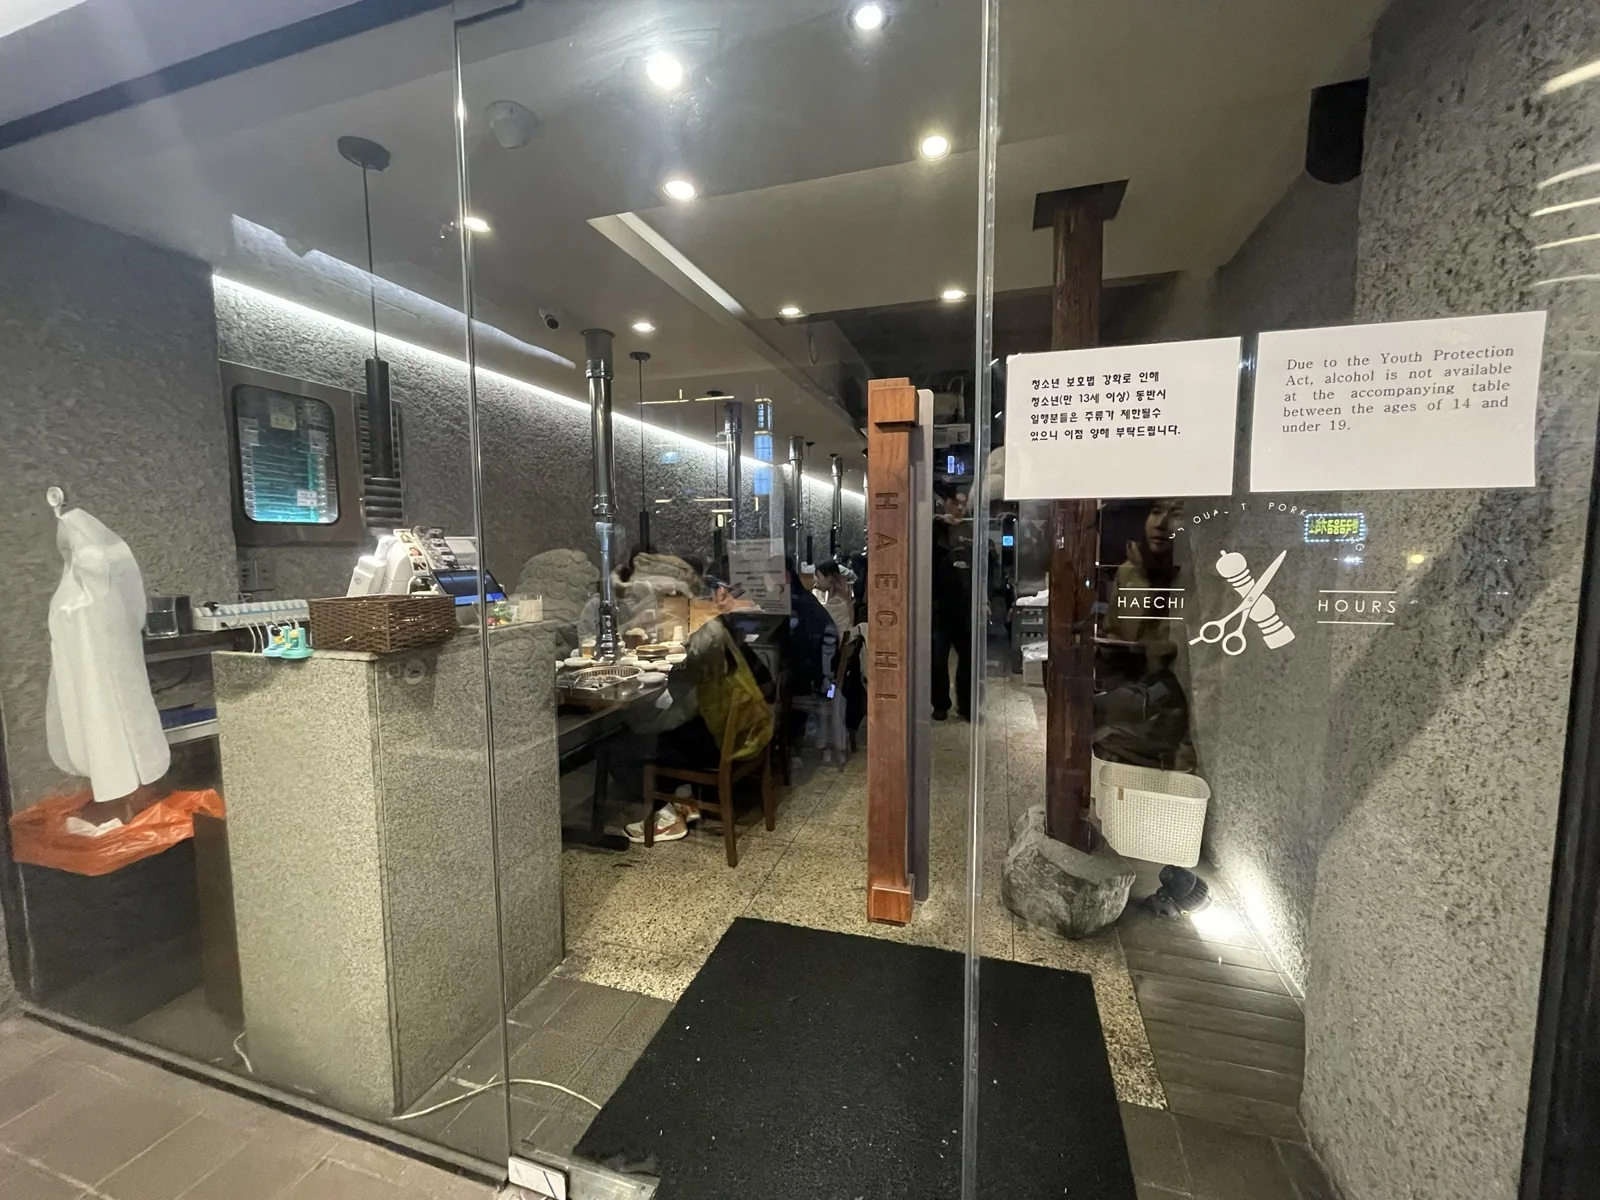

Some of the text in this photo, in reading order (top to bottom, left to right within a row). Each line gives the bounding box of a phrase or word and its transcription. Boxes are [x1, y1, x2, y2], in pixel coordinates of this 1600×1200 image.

[1286, 346, 1515, 371] Due to the Youth Protection
[1031, 370, 1160, 391] 청소년 보호법 강화로 인해
[1285, 363, 1513, 387] Act, alcohol is not available
[1030, 388, 1167, 408] 청소년(만 13세 이상) 동반시
[1283, 380, 1511, 402] at the accompanying table
[1030, 407, 1162, 425] 일행분들은 주류가 제한될수
[1283, 396, 1509, 418] between the ages of 14 and
[1029, 424, 1181, 442] 있으니 이점 양해 부탁드립니다.
[1282, 420, 1351, 433] under 19.
[1268, 502, 1307, 517] PORK
[875, 492, 899, 700] HAECHI
[1117, 596, 1184, 609] HAECHI
[1318, 599, 1396, 614] HOURS
